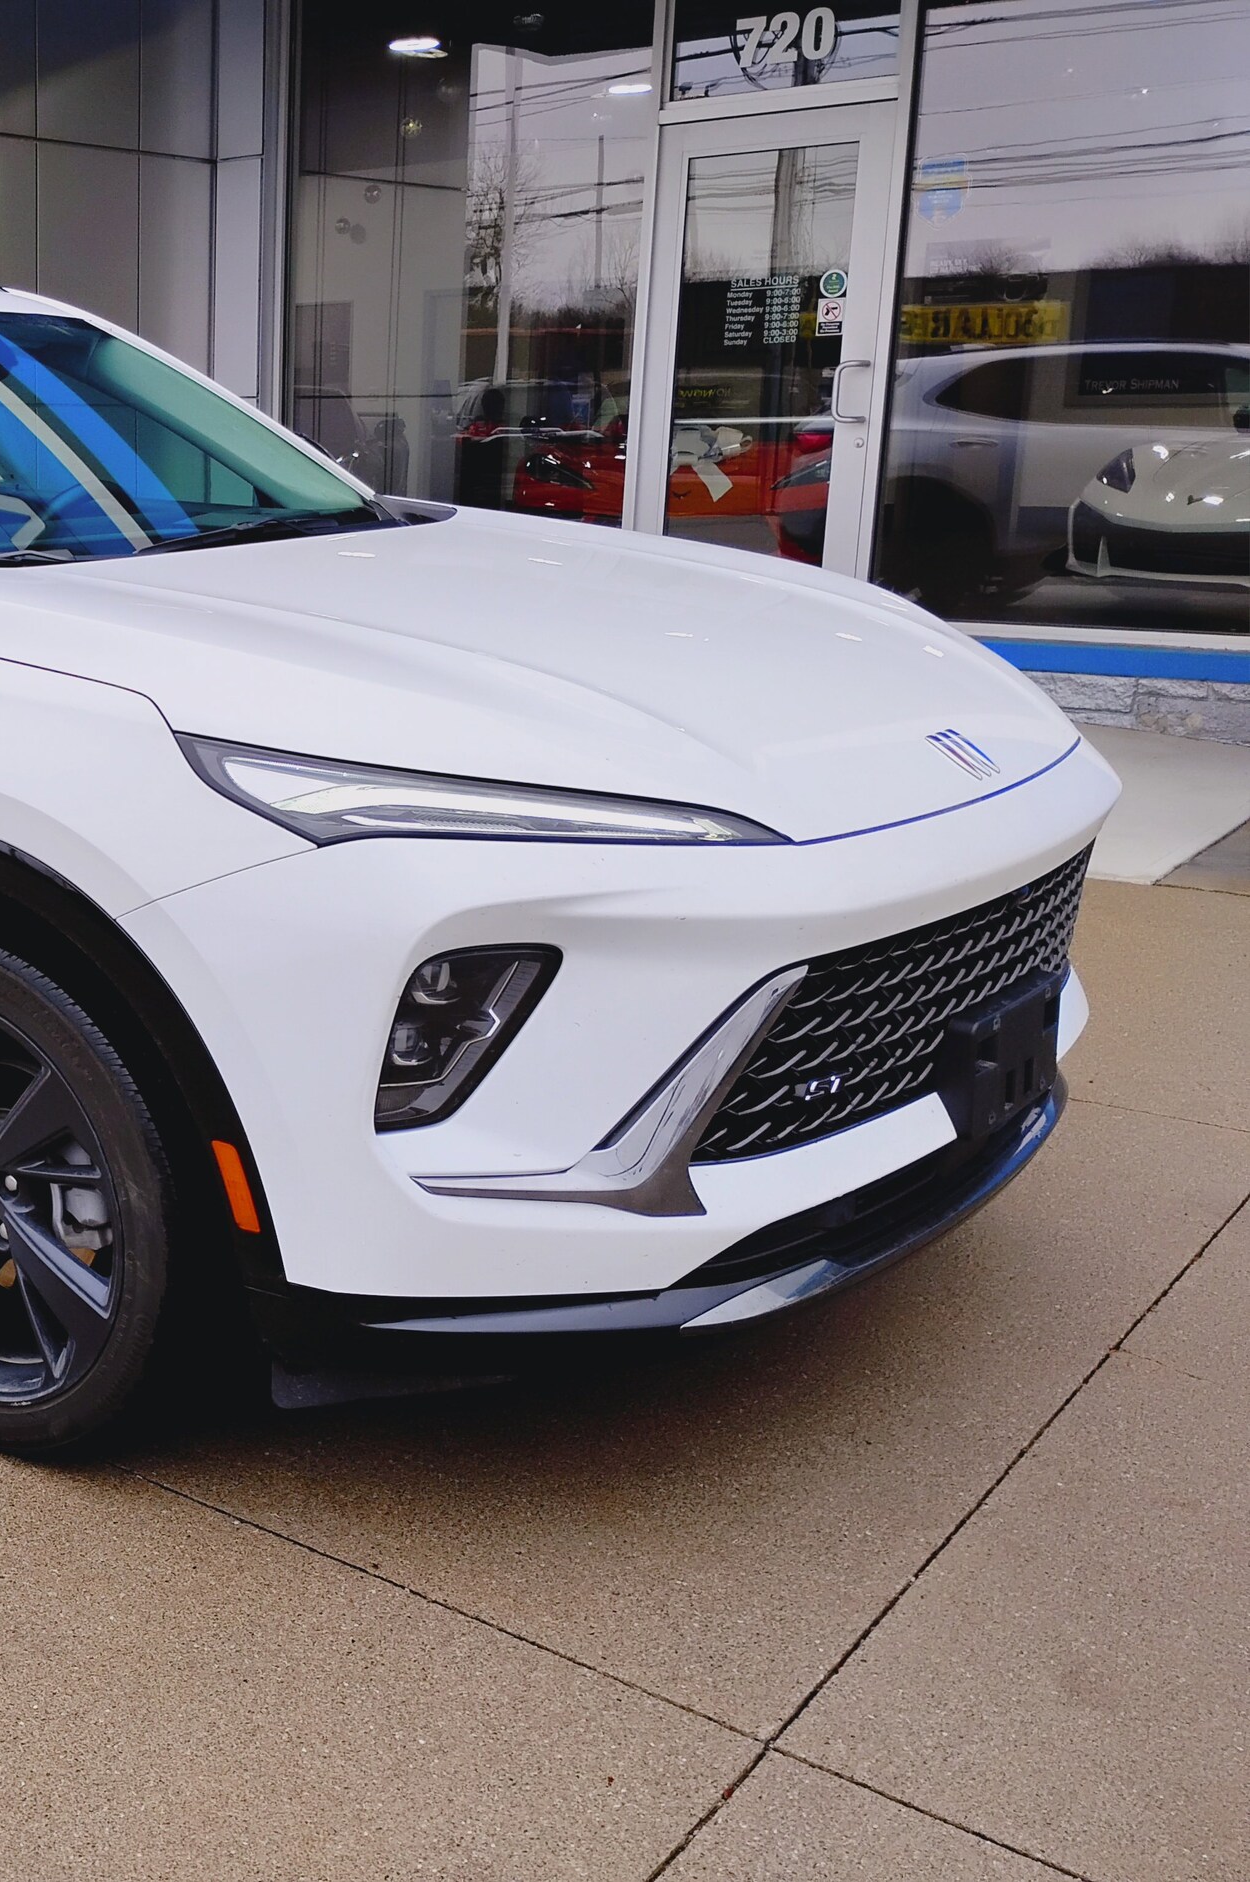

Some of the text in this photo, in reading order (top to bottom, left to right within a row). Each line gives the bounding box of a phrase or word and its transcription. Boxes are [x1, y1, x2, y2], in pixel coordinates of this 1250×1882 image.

[736, 7, 836, 68] 720
[731, 276, 800, 288] SALES HOURS
[726, 291, 753, 299] Monday
[726, 299, 753, 307] Tuesday
[726, 306, 764, 315] Wednesday
[725, 314, 755, 322] Thursday
[723, 335, 797, 346] Sunday CLOSED
[1084, 378, 1180, 391] TREVOR SHIPMAN
